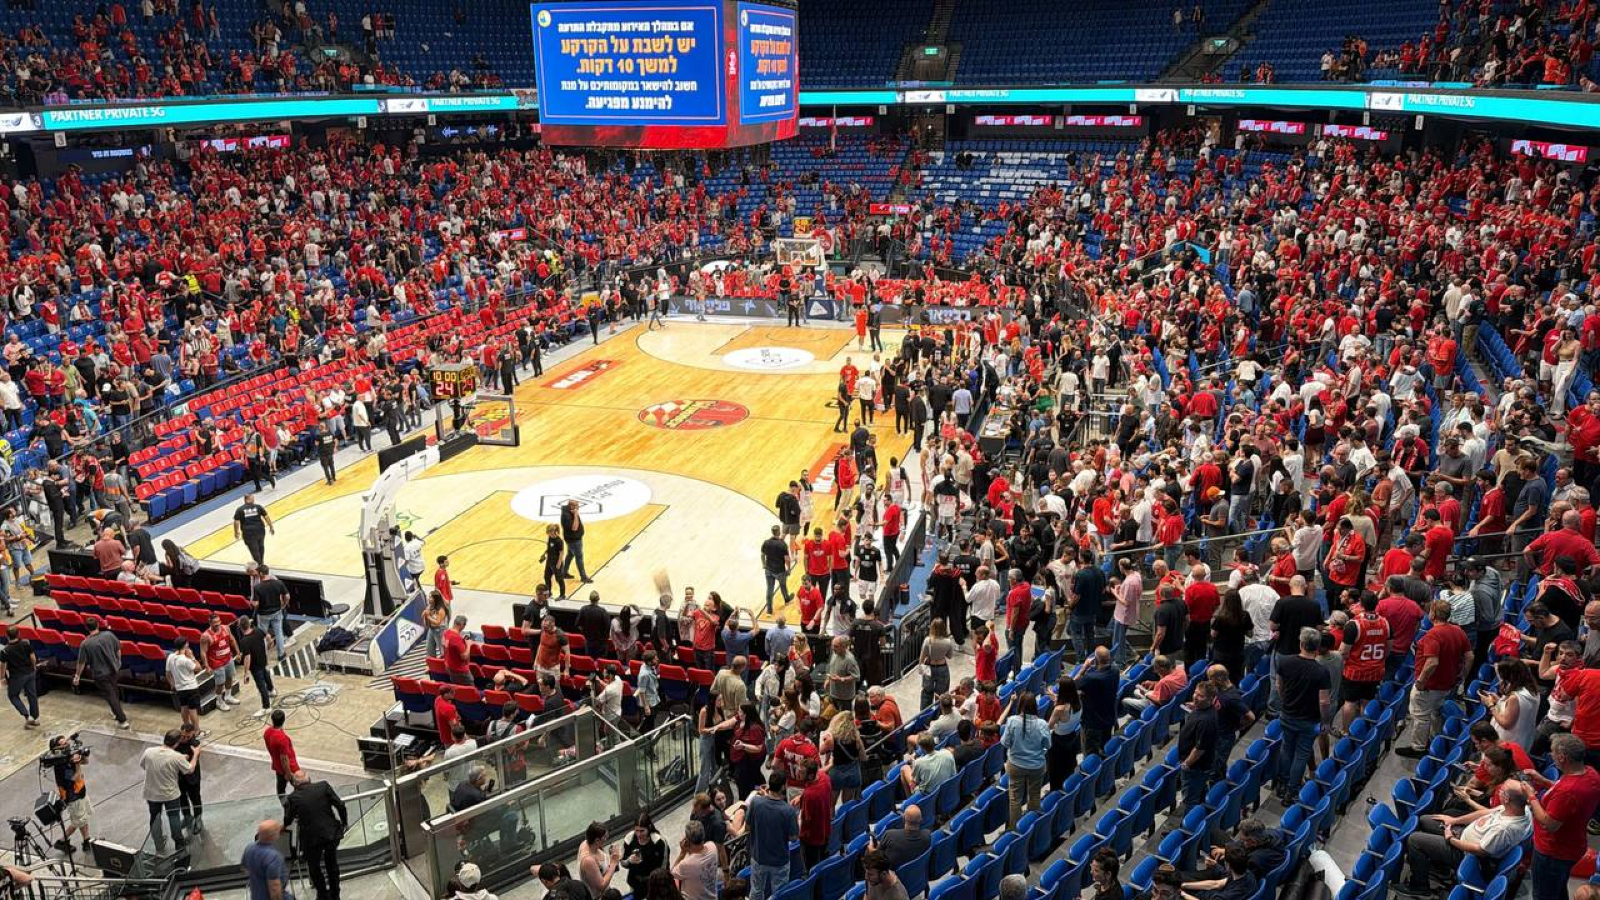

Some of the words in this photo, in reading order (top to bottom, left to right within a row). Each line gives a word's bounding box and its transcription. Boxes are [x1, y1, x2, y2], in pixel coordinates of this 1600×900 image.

[586, 20, 620, 34] מתקבלת
[621, 21, 650, 32] האירוע
[651, 20, 680, 34] במהלך
[680, 20, 694, 31] אם
[561, 39, 608, 56] הקרקע
[610, 35, 629, 53] על
[632, 35, 673, 53] לשבת
[677, 38, 695, 53] יש
[576, 58, 613, 76] דקות.
[617, 58, 634, 73] 10
[637, 55, 677, 76] למשך
[561, 80, 577, 91] מנת
[578, 79, 589, 91] על
[590, 80, 639, 93] במקומותיכם
[641, 79, 673, 91] להישאר
[675, 80, 697, 91] חשוב
[432, 97, 462, 106] PARTNER
[585, 96, 630, 110] מפגיעה.
[631, 94, 672, 109] להימנע
[50, 109, 103, 122] PARTNER
[105, 107, 151, 120] PRIVATE
[151, 107, 166, 117] 5G
[436, 381, 454, 396] 24
[1360, 643, 1385, 660] 26
